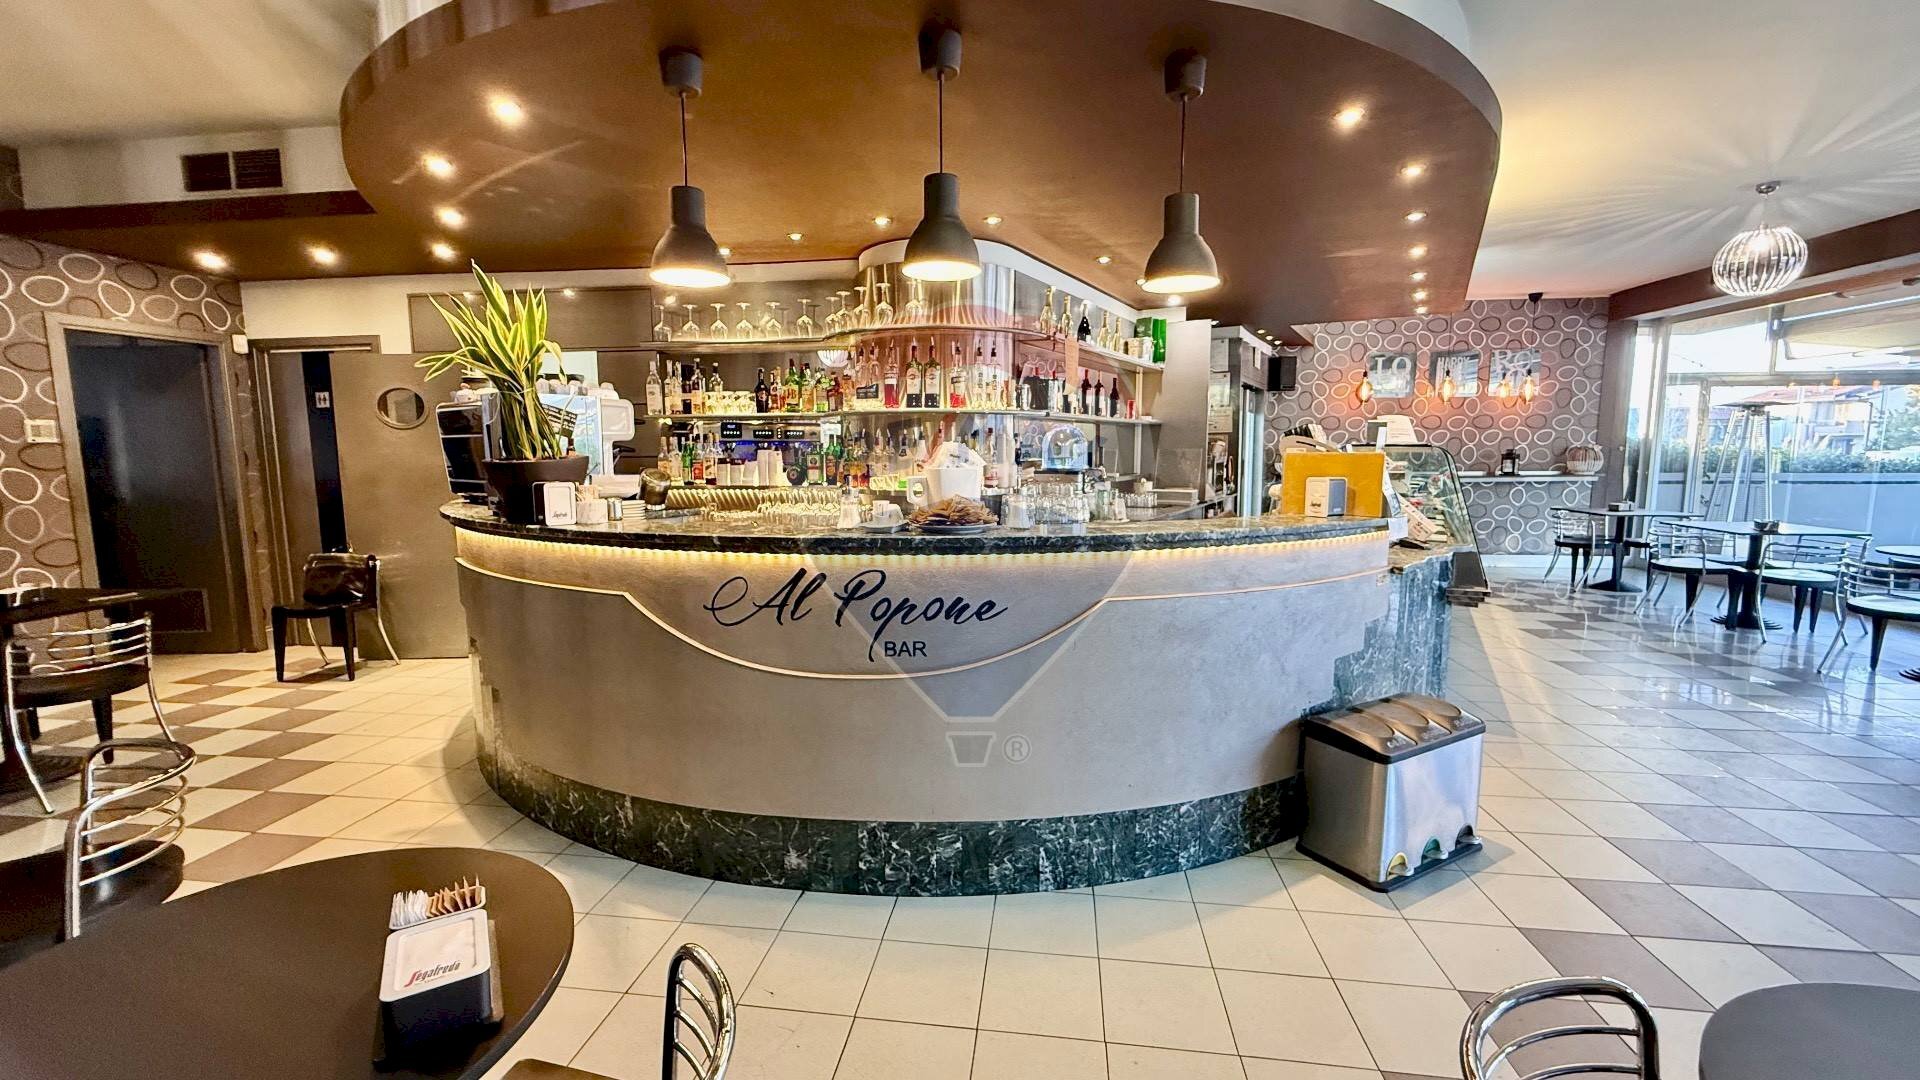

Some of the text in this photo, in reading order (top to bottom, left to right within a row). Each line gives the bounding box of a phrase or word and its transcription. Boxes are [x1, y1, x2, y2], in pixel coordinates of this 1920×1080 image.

[703, 568, 1008, 662] Al Popone
[884, 641, 928, 658] BAR
[403, 959, 461, 988] Segafredo
